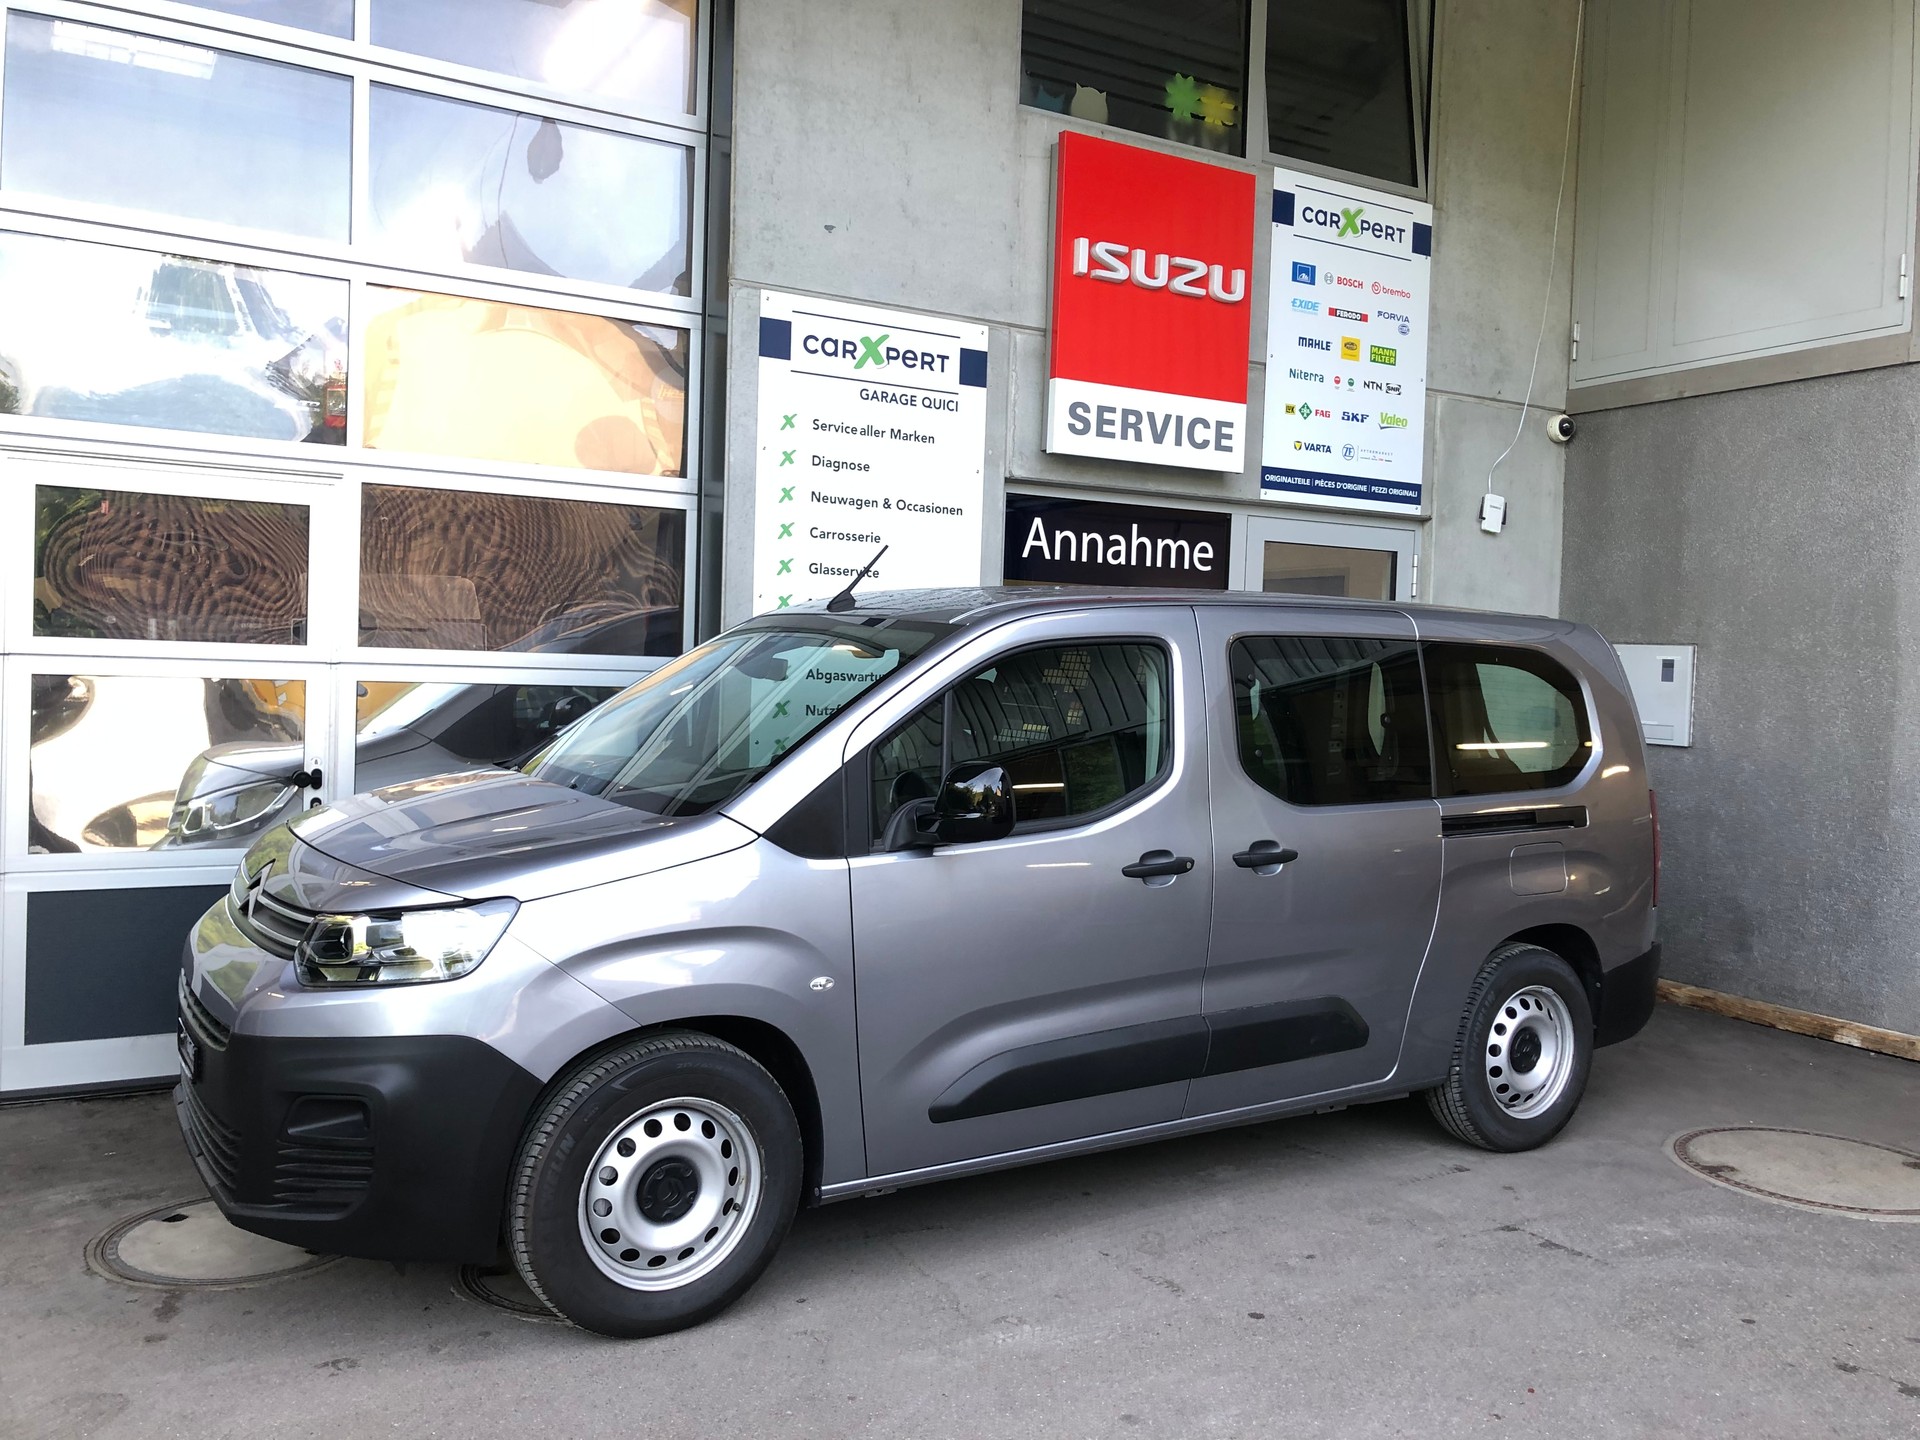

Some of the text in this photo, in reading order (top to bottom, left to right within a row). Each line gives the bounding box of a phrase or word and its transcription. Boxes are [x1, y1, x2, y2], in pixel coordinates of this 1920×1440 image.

[1073, 236, 1246, 303] ISUZU
[1337, 276, 1364, 289] BOSCH
[1382, 286, 1411, 299] brembo
[1291, 298, 1320, 312] EXIDE
[1336, 309, 1361, 321] FERODO
[1377, 311, 1410, 323] FORVIA
[1298, 336, 1331, 351] MAHLE
[1371, 346, 1396, 357] MANN
[1371, 354, 1395, 365] FILTER
[1289, 368, 1324, 383] Niterra
[1363, 380, 1383, 391] NTN
[859, 388, 959, 412] GARAGE QUICI
[1315, 409, 1331, 418] FAG
[1341, 411, 1369, 423] SKF
[1380, 412, 1408, 428] Valeo
[812, 419, 935, 444] Service aller Marken
[1067, 401, 1235, 453] SERVICE
[1304, 442, 1332, 454] VARTA
[811, 455, 870, 472] Diagnose
[1264, 474, 1418, 497] ORIGINALTEILE PIÈCES D'ORIGINE PEZZI ORIGINALI
[811, 491, 963, 516] Neuwagen & Occasionen
[809, 527, 881, 544] Carrosserie
[1021, 516, 1214, 571] Annahme
[805, 668, 886, 684] Abgaswartu
